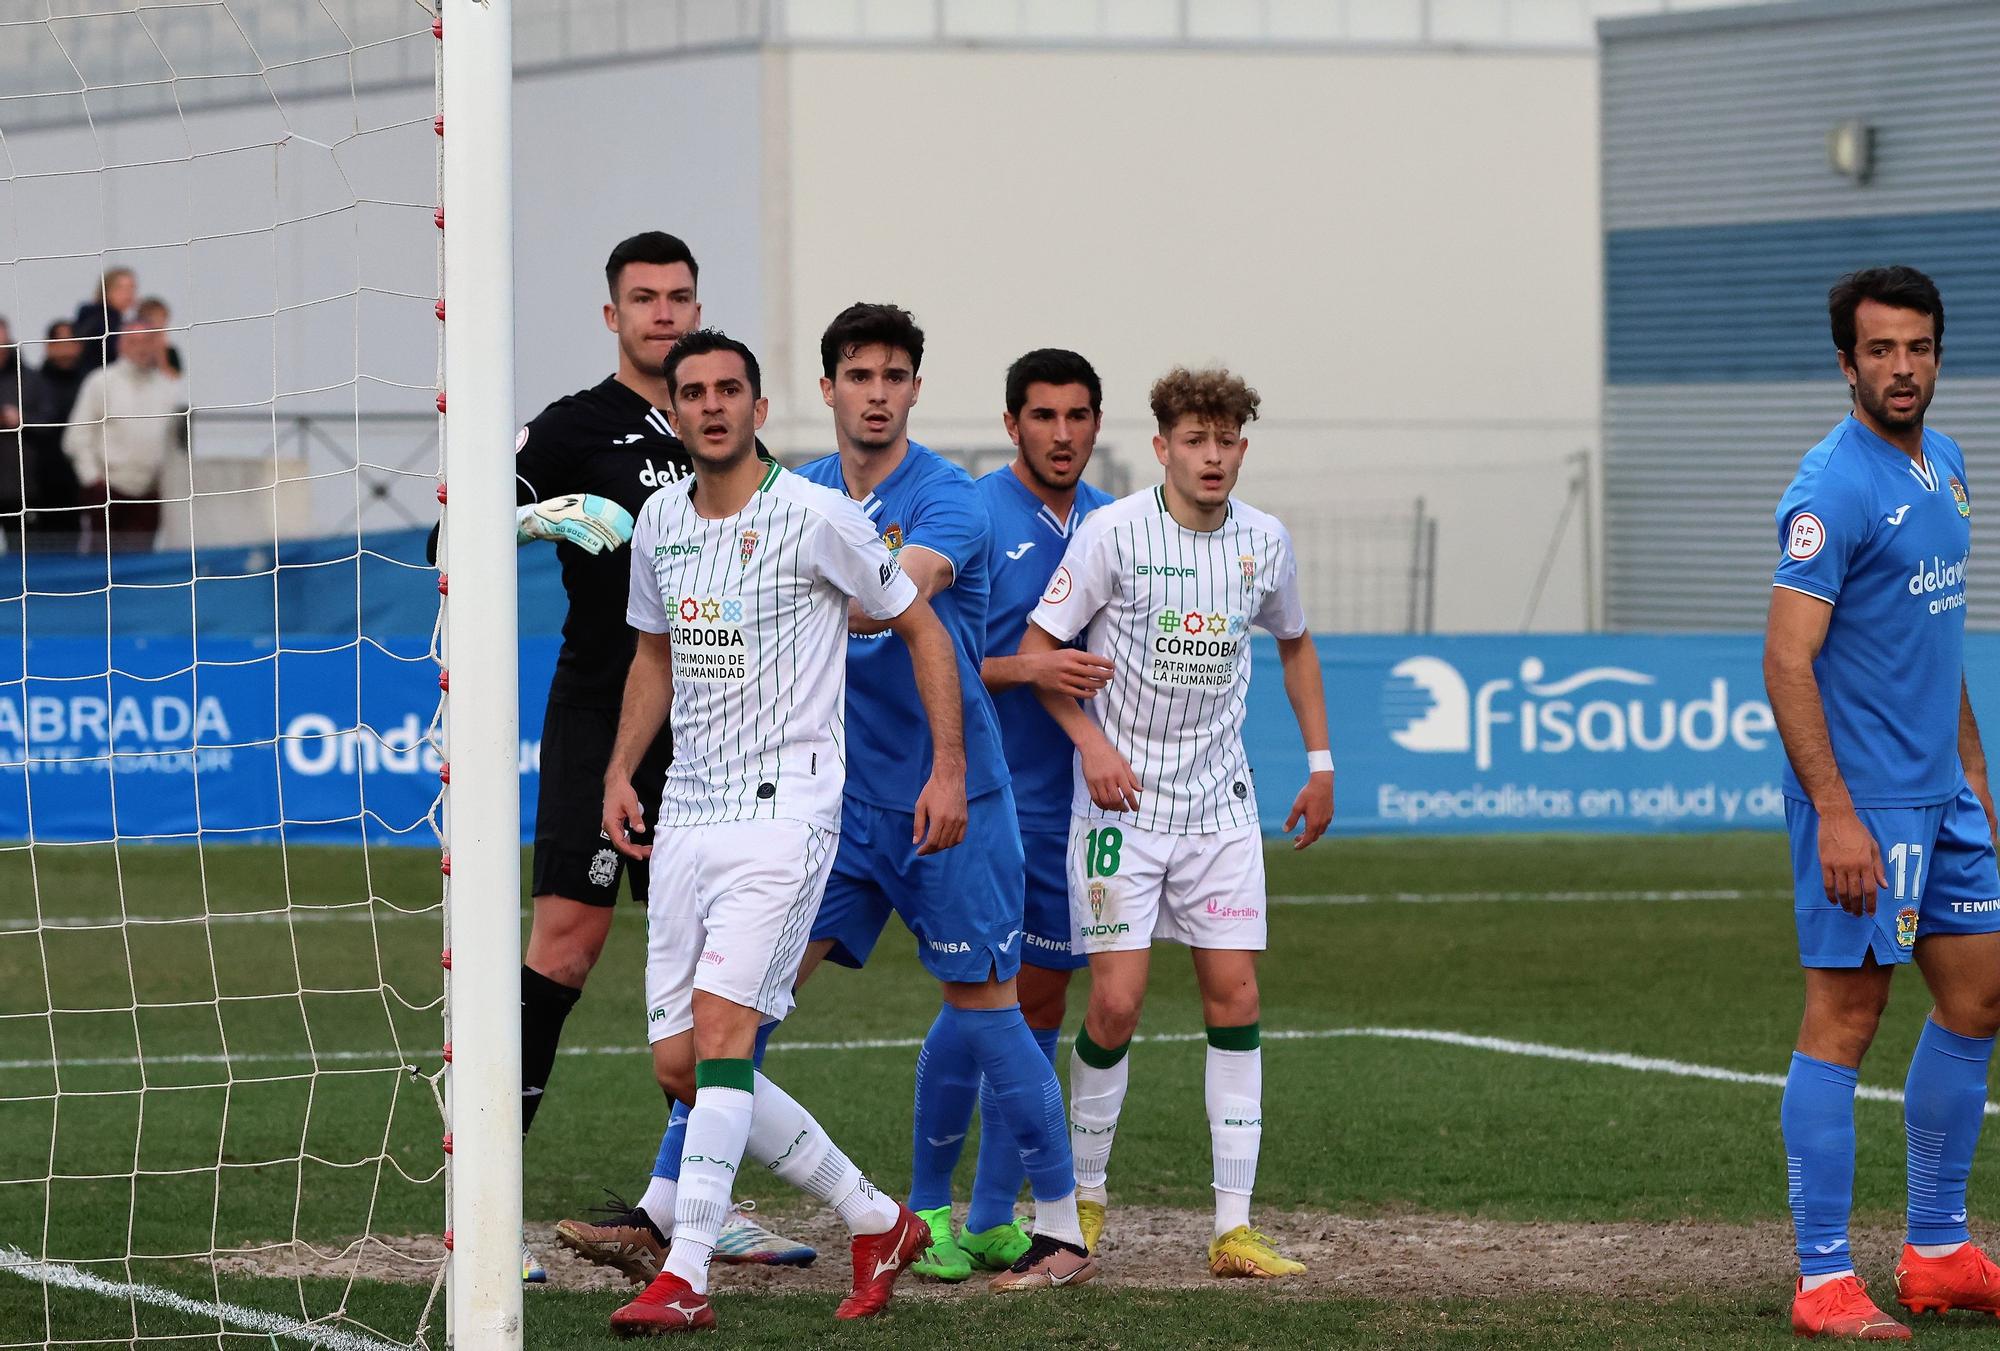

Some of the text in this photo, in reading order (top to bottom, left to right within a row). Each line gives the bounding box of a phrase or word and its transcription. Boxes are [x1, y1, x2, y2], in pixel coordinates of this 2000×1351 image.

[1136, 565, 1196, 578] GIVOVA
[671, 624, 744, 647] CÓRDOBA
[1155, 636, 1237, 657] CÓRDOBA
[728, 654, 745, 666] DE
[1154, 659, 1232, 674] PATRIMONIO DE
[1153, 670, 1232, 686] LA HUMANIDAD
[0, 696, 231, 742] ABRADA
[1475, 657, 1778, 771] fisaude
[1378, 783, 1574, 824] Especialistas
[1579, 788, 1625, 817] en
[1629, 781, 1716, 818] salud
[1720, 786, 1743, 822] y
[1086, 826, 1123, 879] 18
[1889, 843, 1923, 900] 17
[1951, 898, 2000, 913] TEMIN
[1081, 923, 1130, 937] GIVOVA
